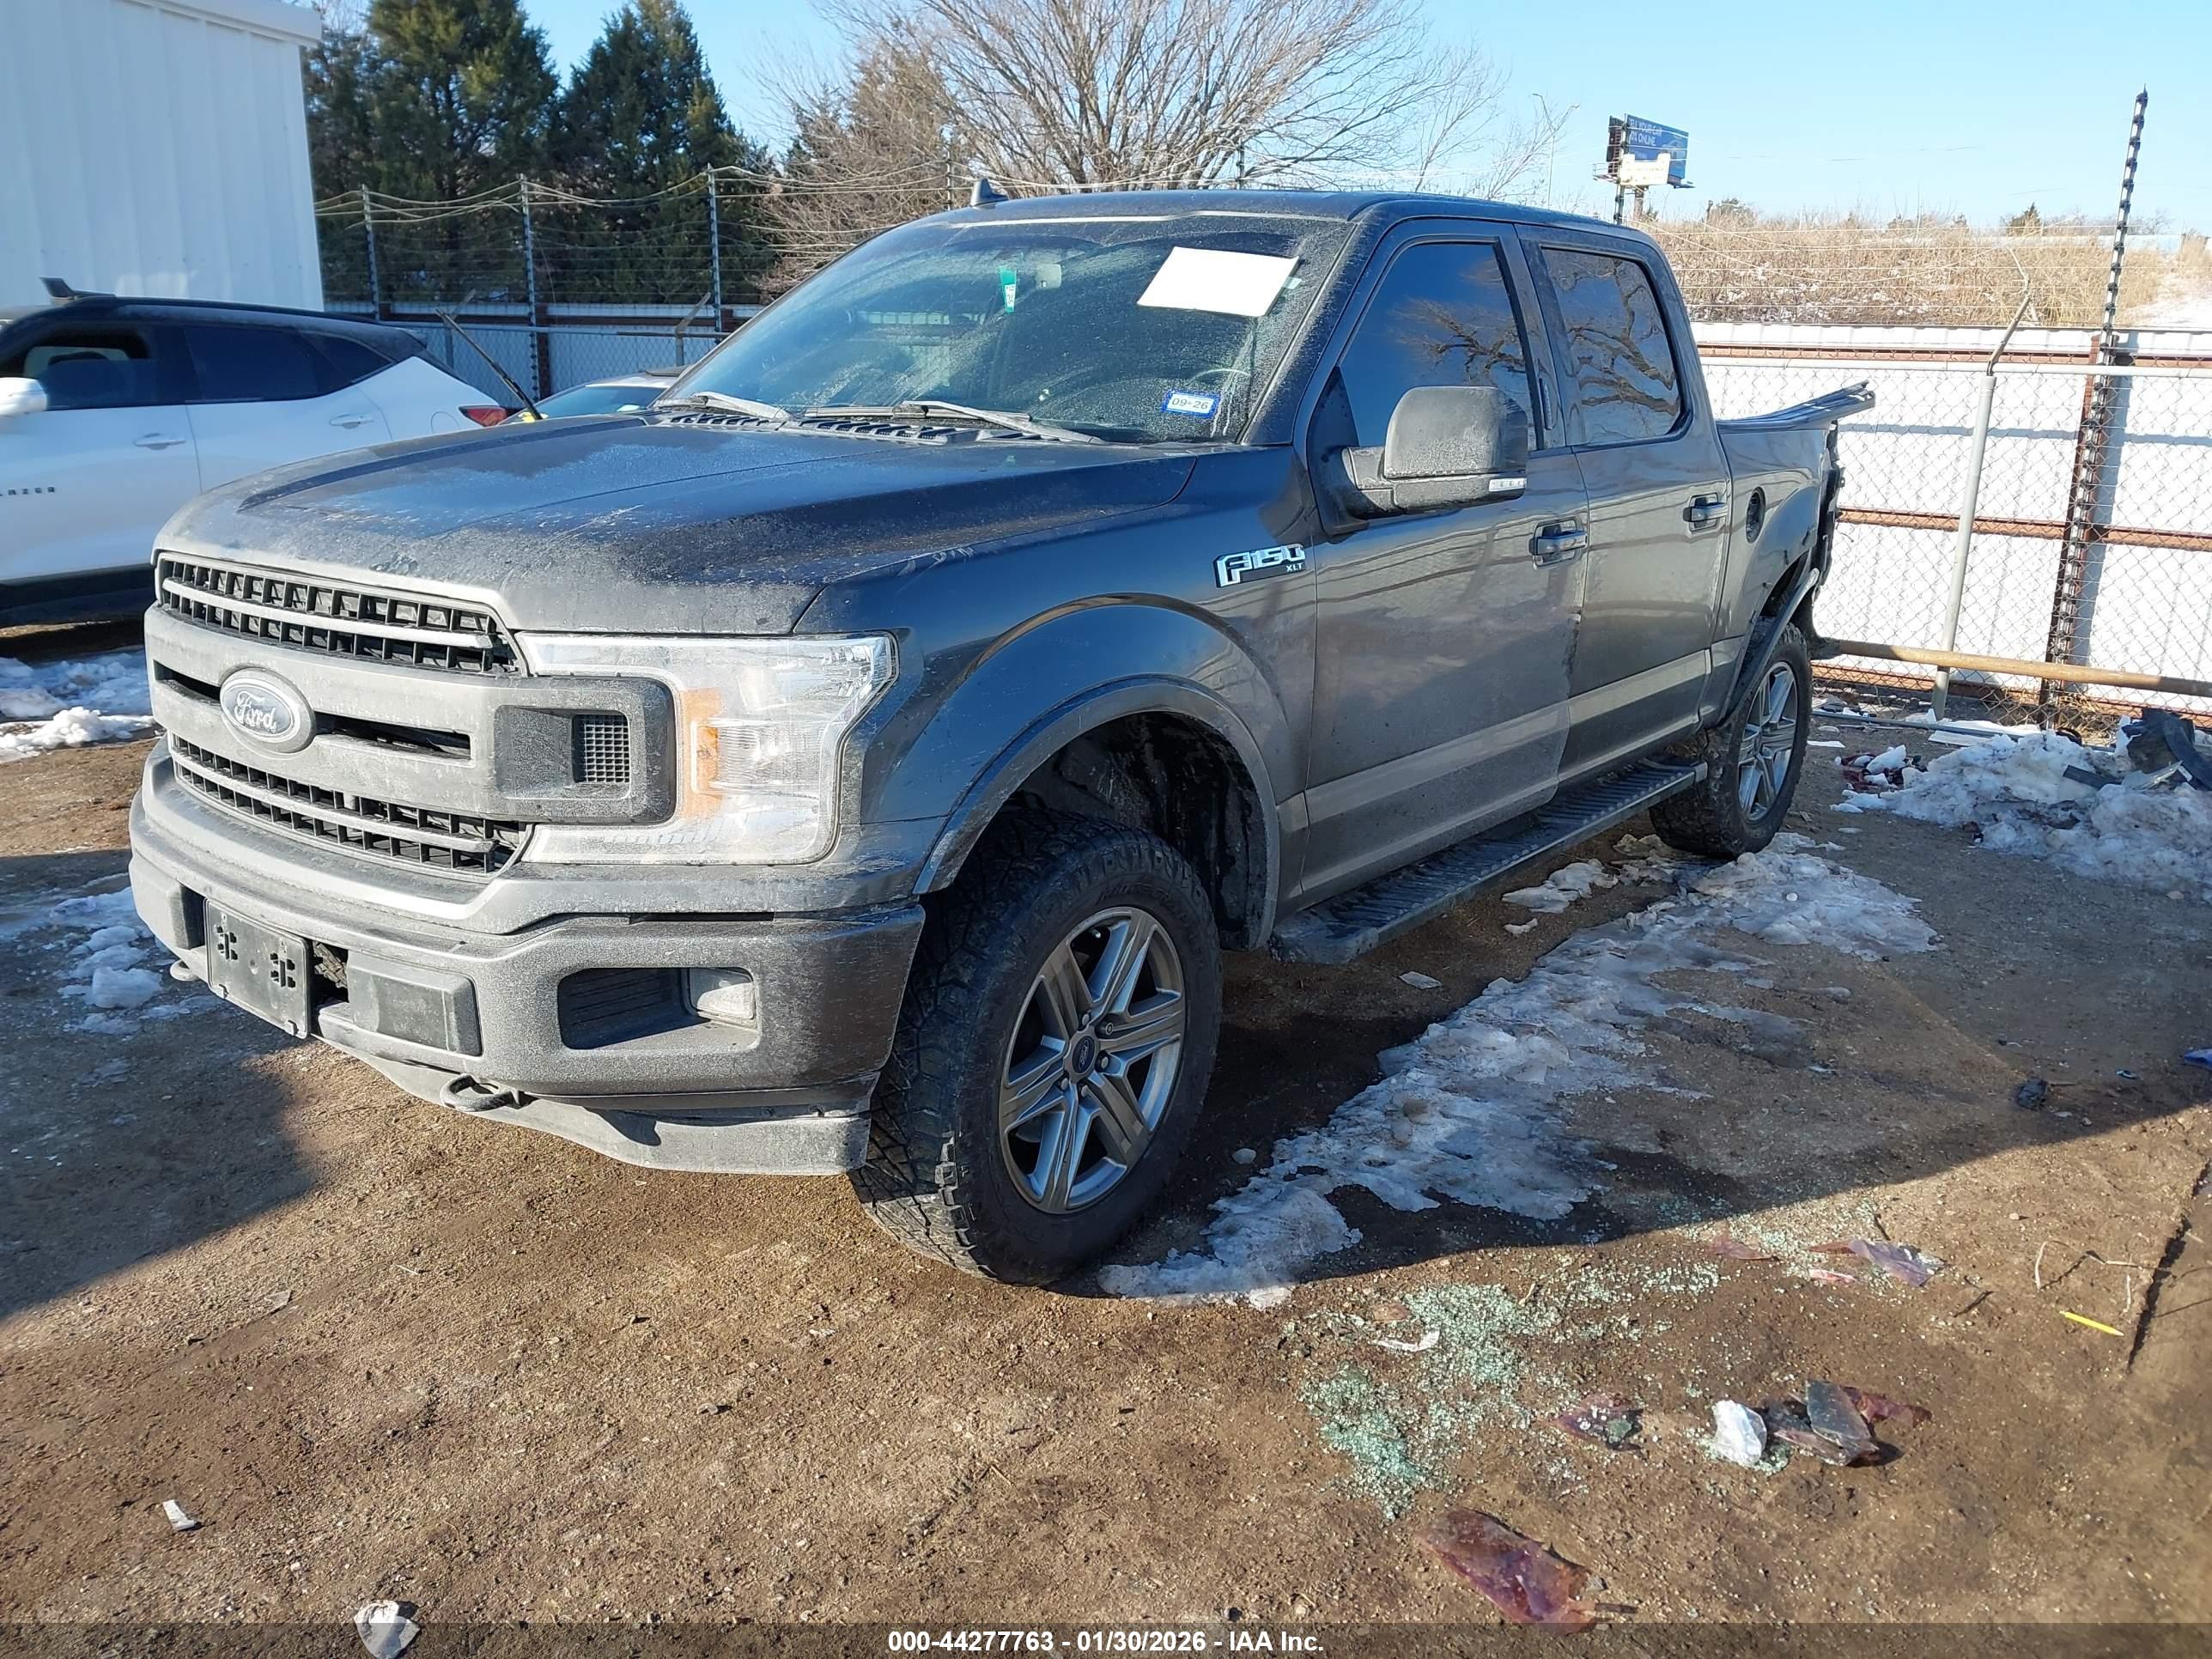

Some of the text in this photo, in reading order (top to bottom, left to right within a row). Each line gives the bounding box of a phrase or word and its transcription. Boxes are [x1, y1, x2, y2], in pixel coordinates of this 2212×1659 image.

[1171, 398, 1209, 410] 09-26
[1285, 562, 1304, 573] XLT
[234, 690, 278, 734] Ford
